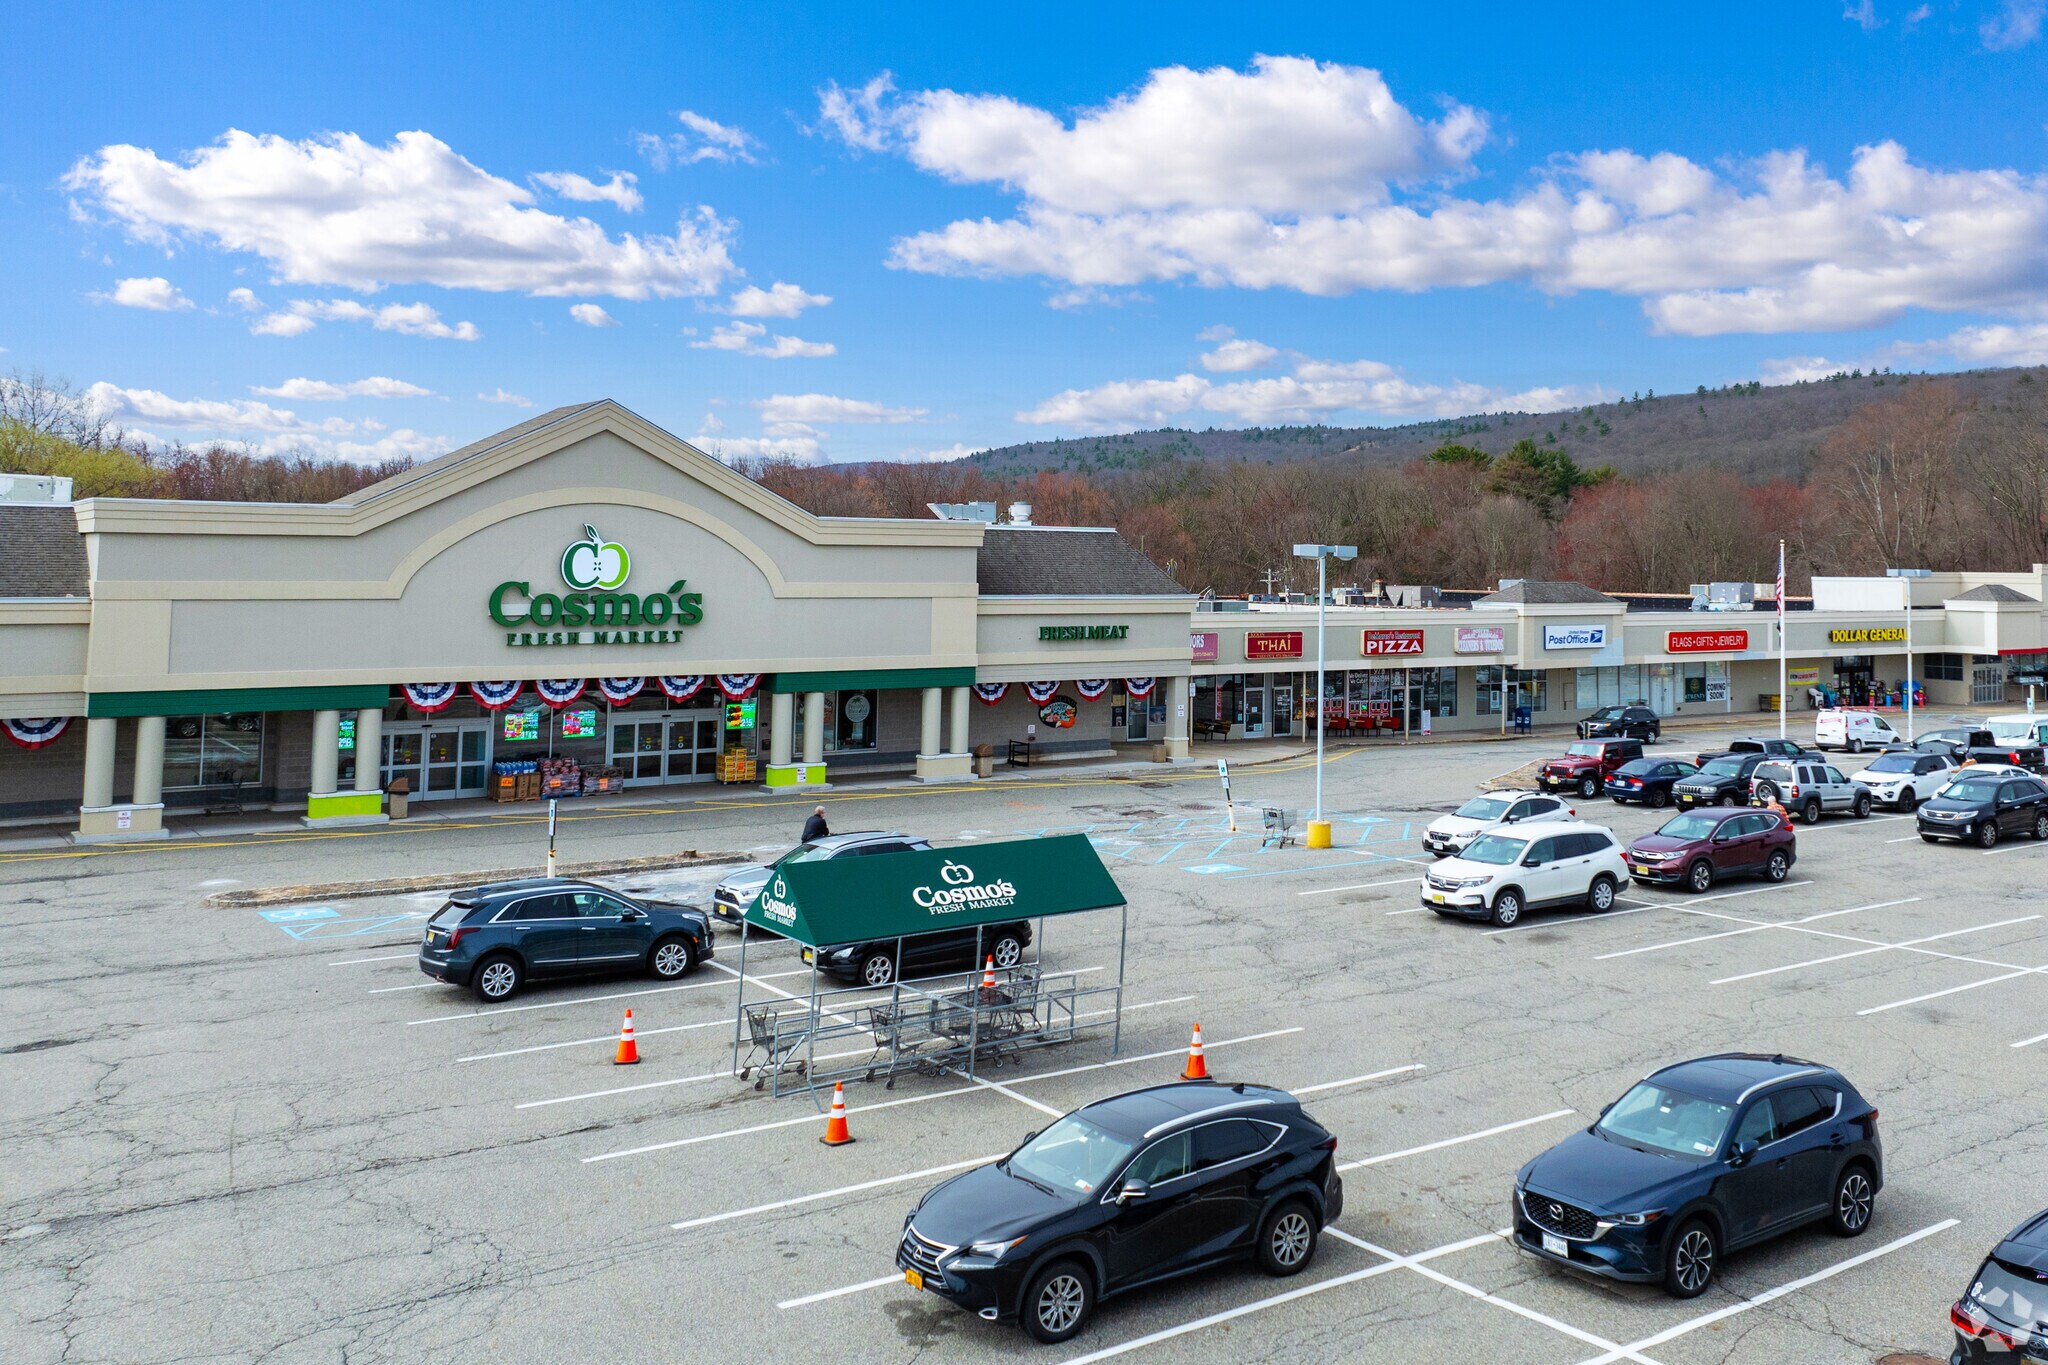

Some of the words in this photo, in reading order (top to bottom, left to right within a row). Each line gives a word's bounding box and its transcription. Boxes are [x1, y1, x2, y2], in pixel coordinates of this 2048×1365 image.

[489, 579, 704, 627] Cosmo's
[506, 632, 580, 647] FRESH
[593, 629, 684, 646] MARKET
[1039, 626, 1087, 640] FRESH
[1087, 625, 1129, 639] MEAT
[1549, 634, 1566, 645] Post
[1566, 634, 1589, 644] Office
[1832, 629, 1869, 643] DOLLAR
[1869, 628, 1908, 641] GENERAL
[1366, 639, 1422, 654] PIZZA
[1672, 637, 1692, 648] FLAGS
[1695, 636, 1714, 647] GIFTS
[1717, 635, 1745, 646] JEWELRY
[1706, 683, 1726, 692] COMING
[1709, 691, 1725, 700] SOON!
[912, 878, 1017, 908] Cosmo's
[761, 890, 797, 921] Cosmo's
[929, 902, 965, 916] FRESH
[970, 896, 1015, 911] MARKET
